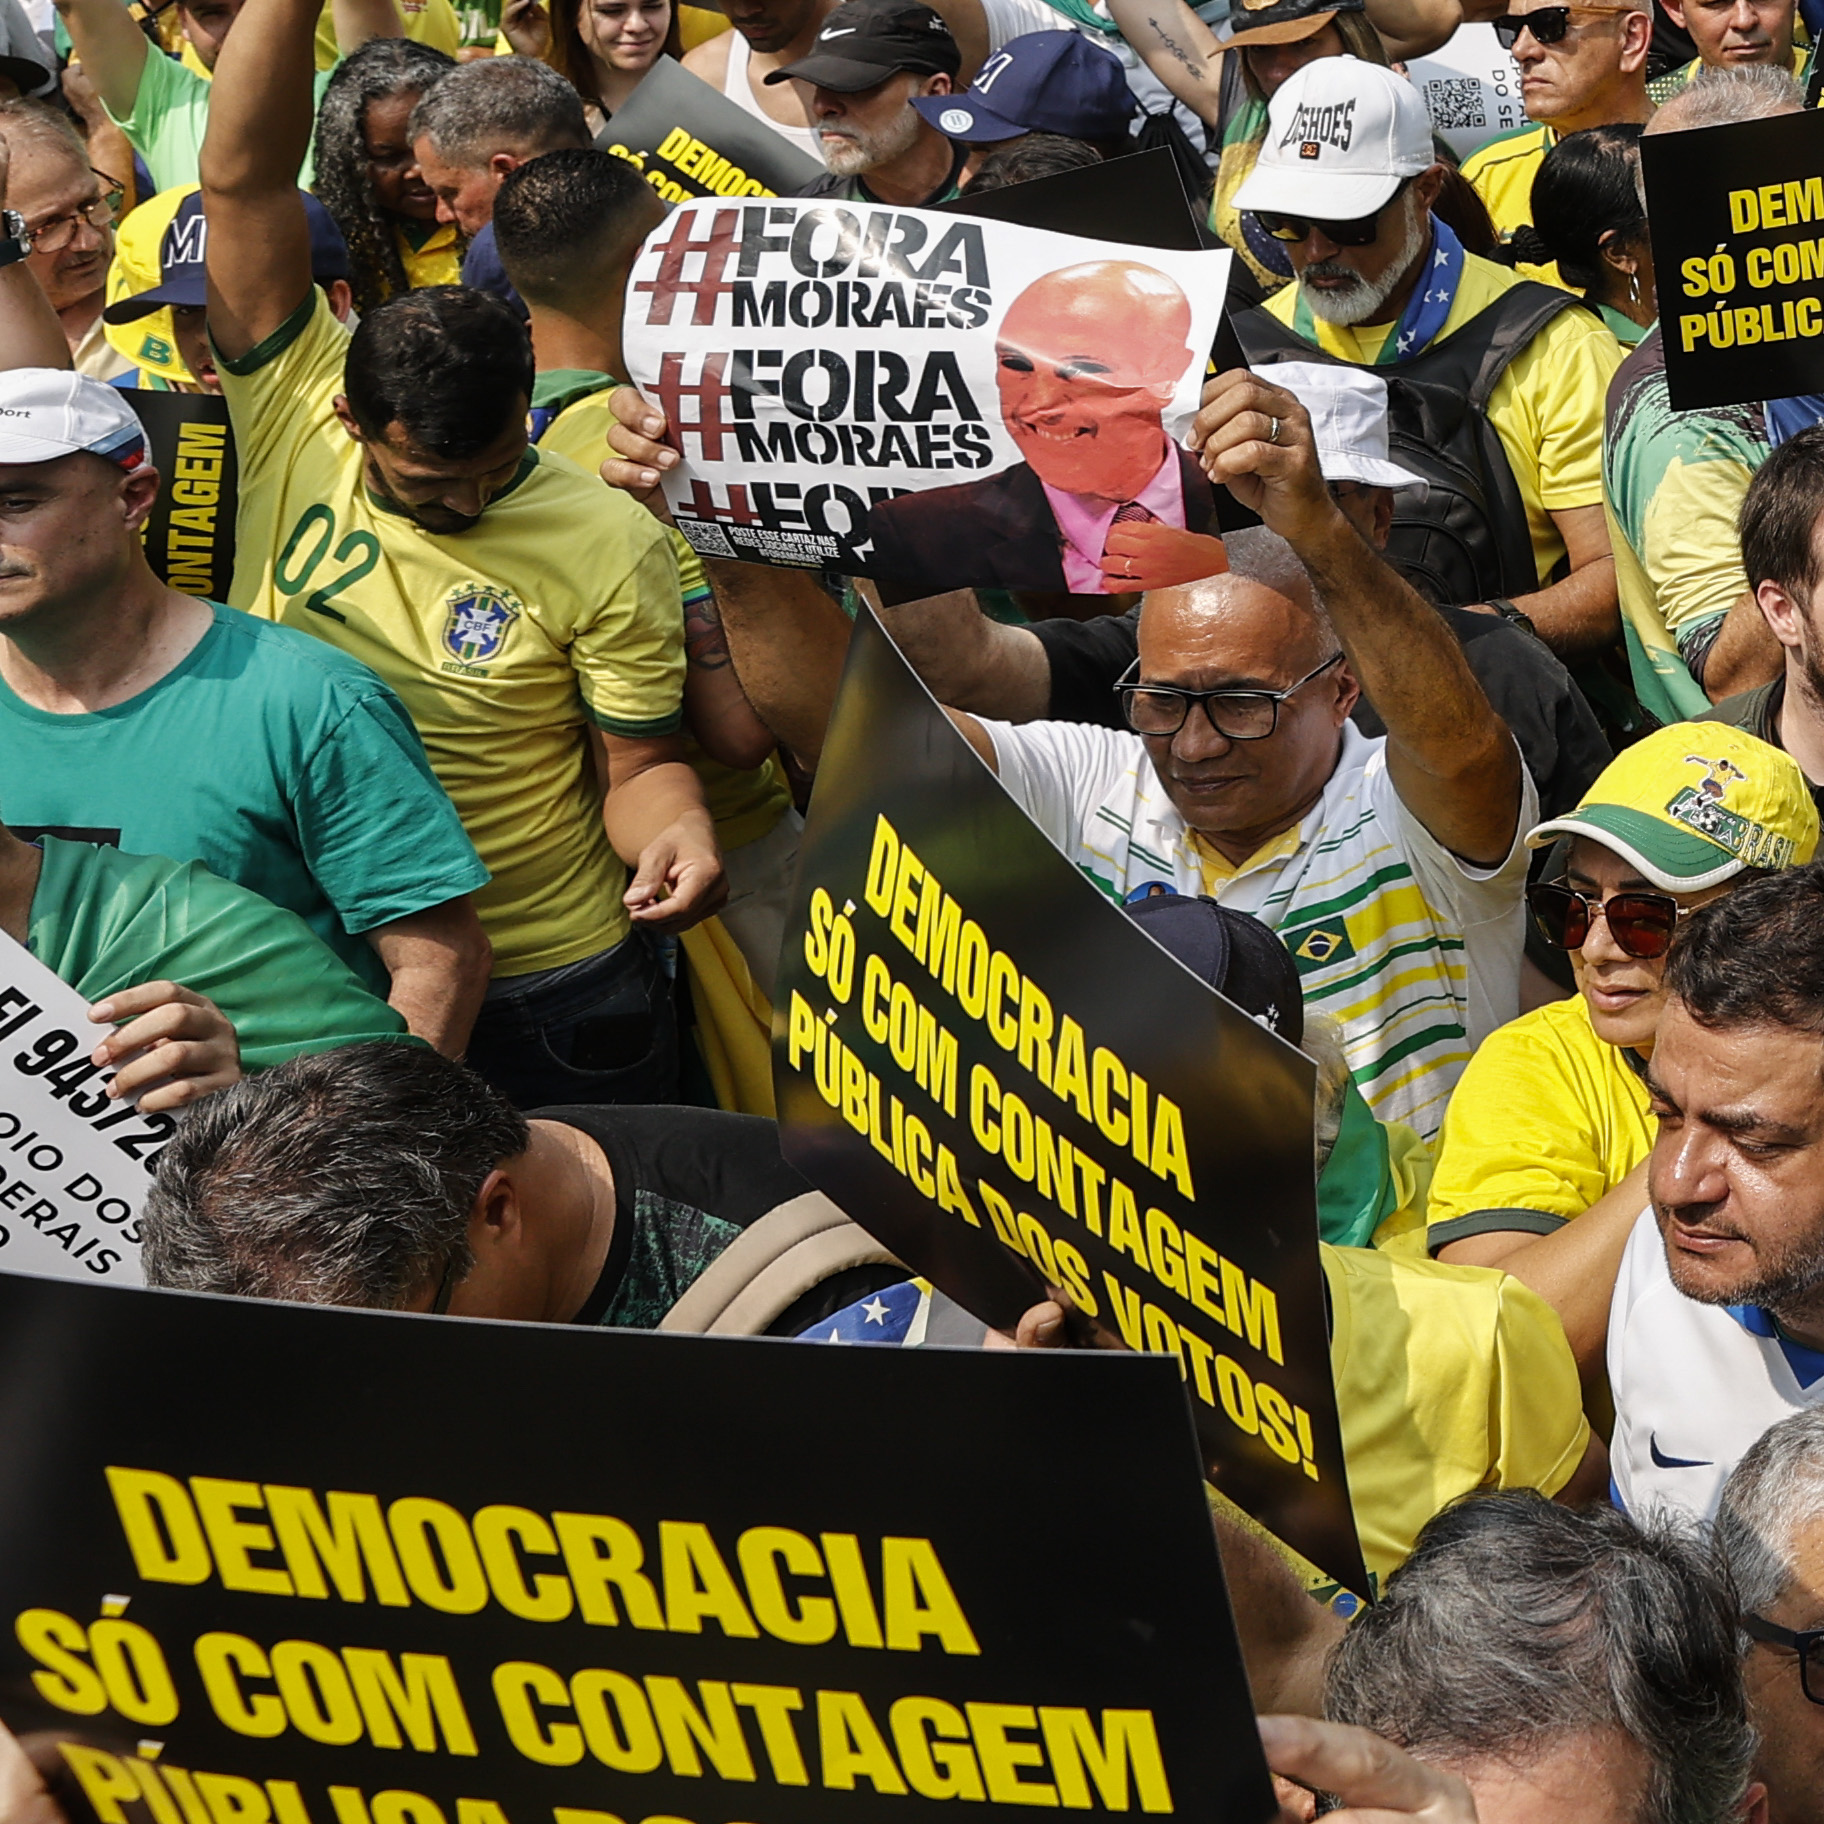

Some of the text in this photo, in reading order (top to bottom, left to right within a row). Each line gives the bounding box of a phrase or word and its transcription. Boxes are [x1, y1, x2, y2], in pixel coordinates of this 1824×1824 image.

[731, 280, 994, 330] MORAES
[1679, 242, 1738, 299] SÓ
[736, 420, 994, 470] MORAES
[276, 501, 381, 624] 02
[463, 619, 492, 634] CBF
[862, 811, 1196, 1203] DEMOCRACIA
[787, 988, 1101, 1320] PÚBLICA DOS
[804, 885, 1285, 1368] SÓ COM CONTAGEM
[103, 1463, 983, 1657] DEMOCRACIA
[13, 1592, 180, 1731] SÓ
[190, 1630, 480, 1761] COM
[488, 1659, 1176, 1817] CONTAGEM
